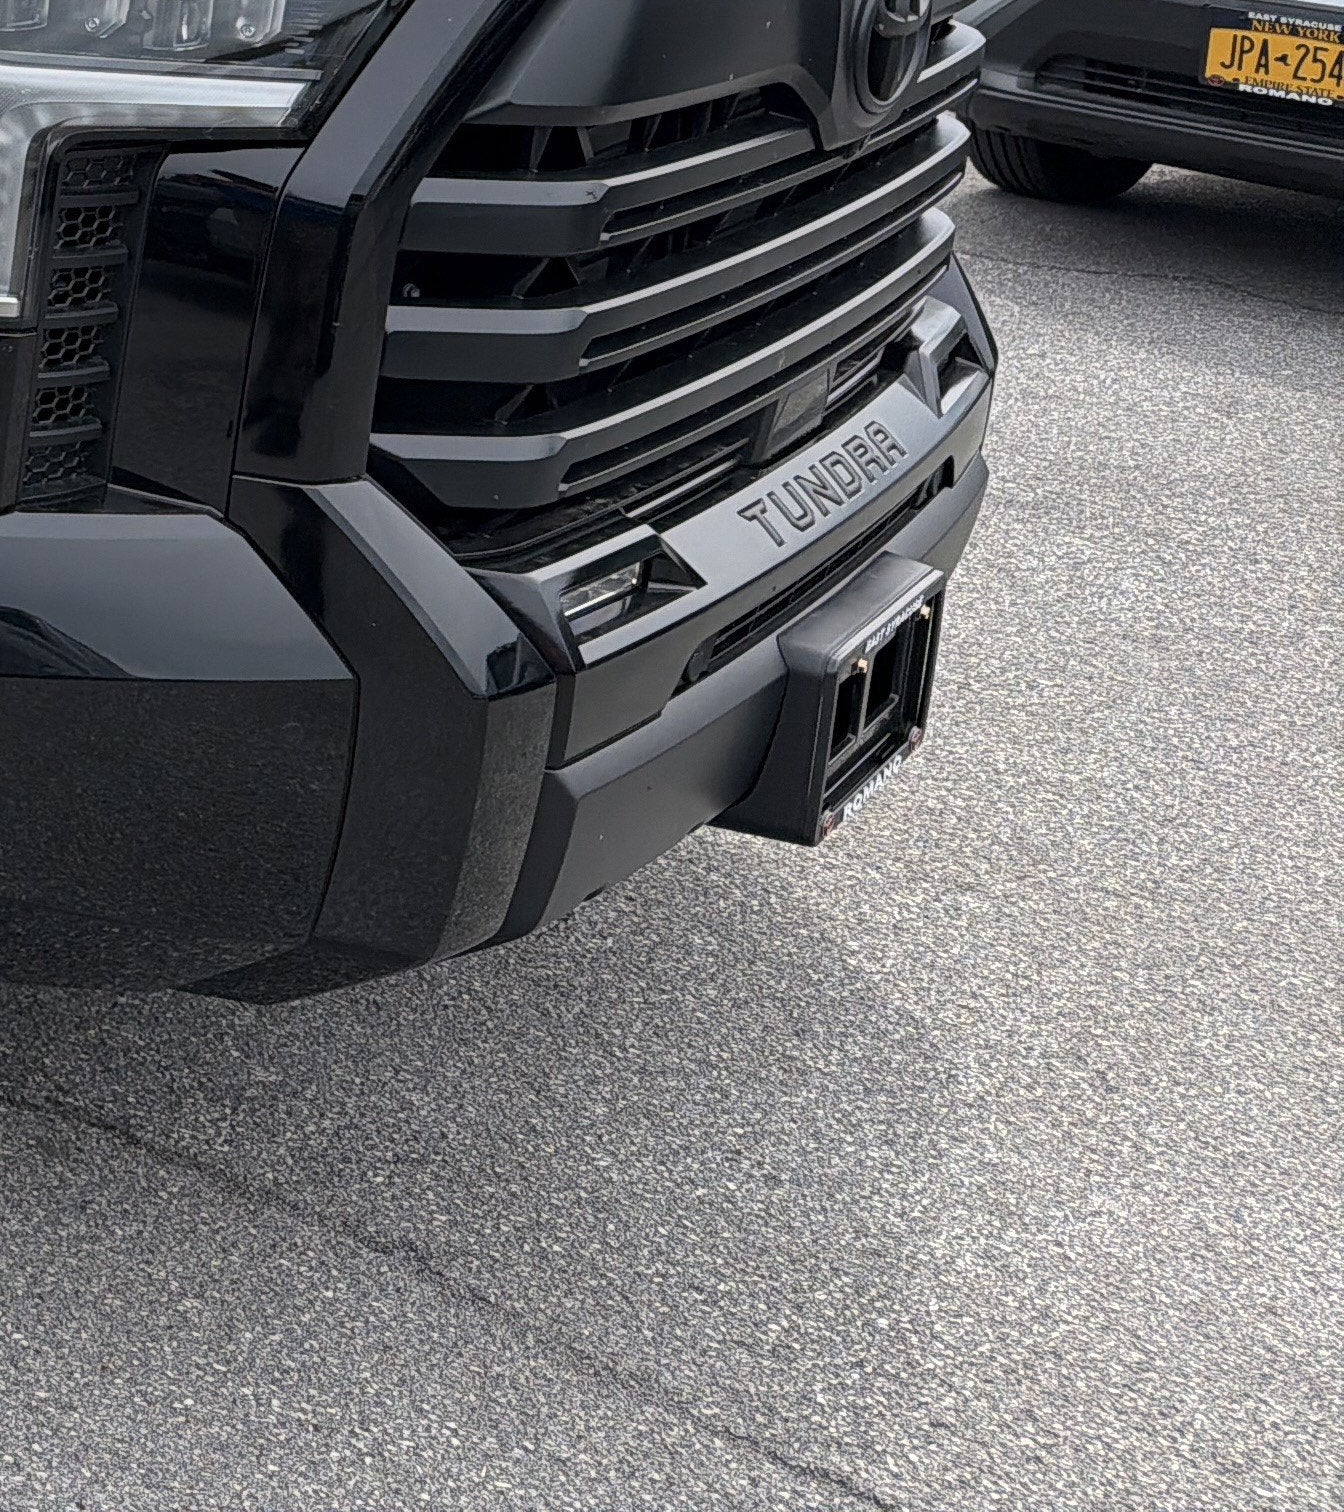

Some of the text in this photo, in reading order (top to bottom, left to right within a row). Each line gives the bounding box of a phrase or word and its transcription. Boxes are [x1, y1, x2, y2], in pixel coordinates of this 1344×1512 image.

[1251, 20, 1341, 43] NEW YORK
[1239, 83, 1333, 106] ROMANO
[737, 420, 908, 547] TUNDRA
[842, 754, 902, 822] ROMANO
